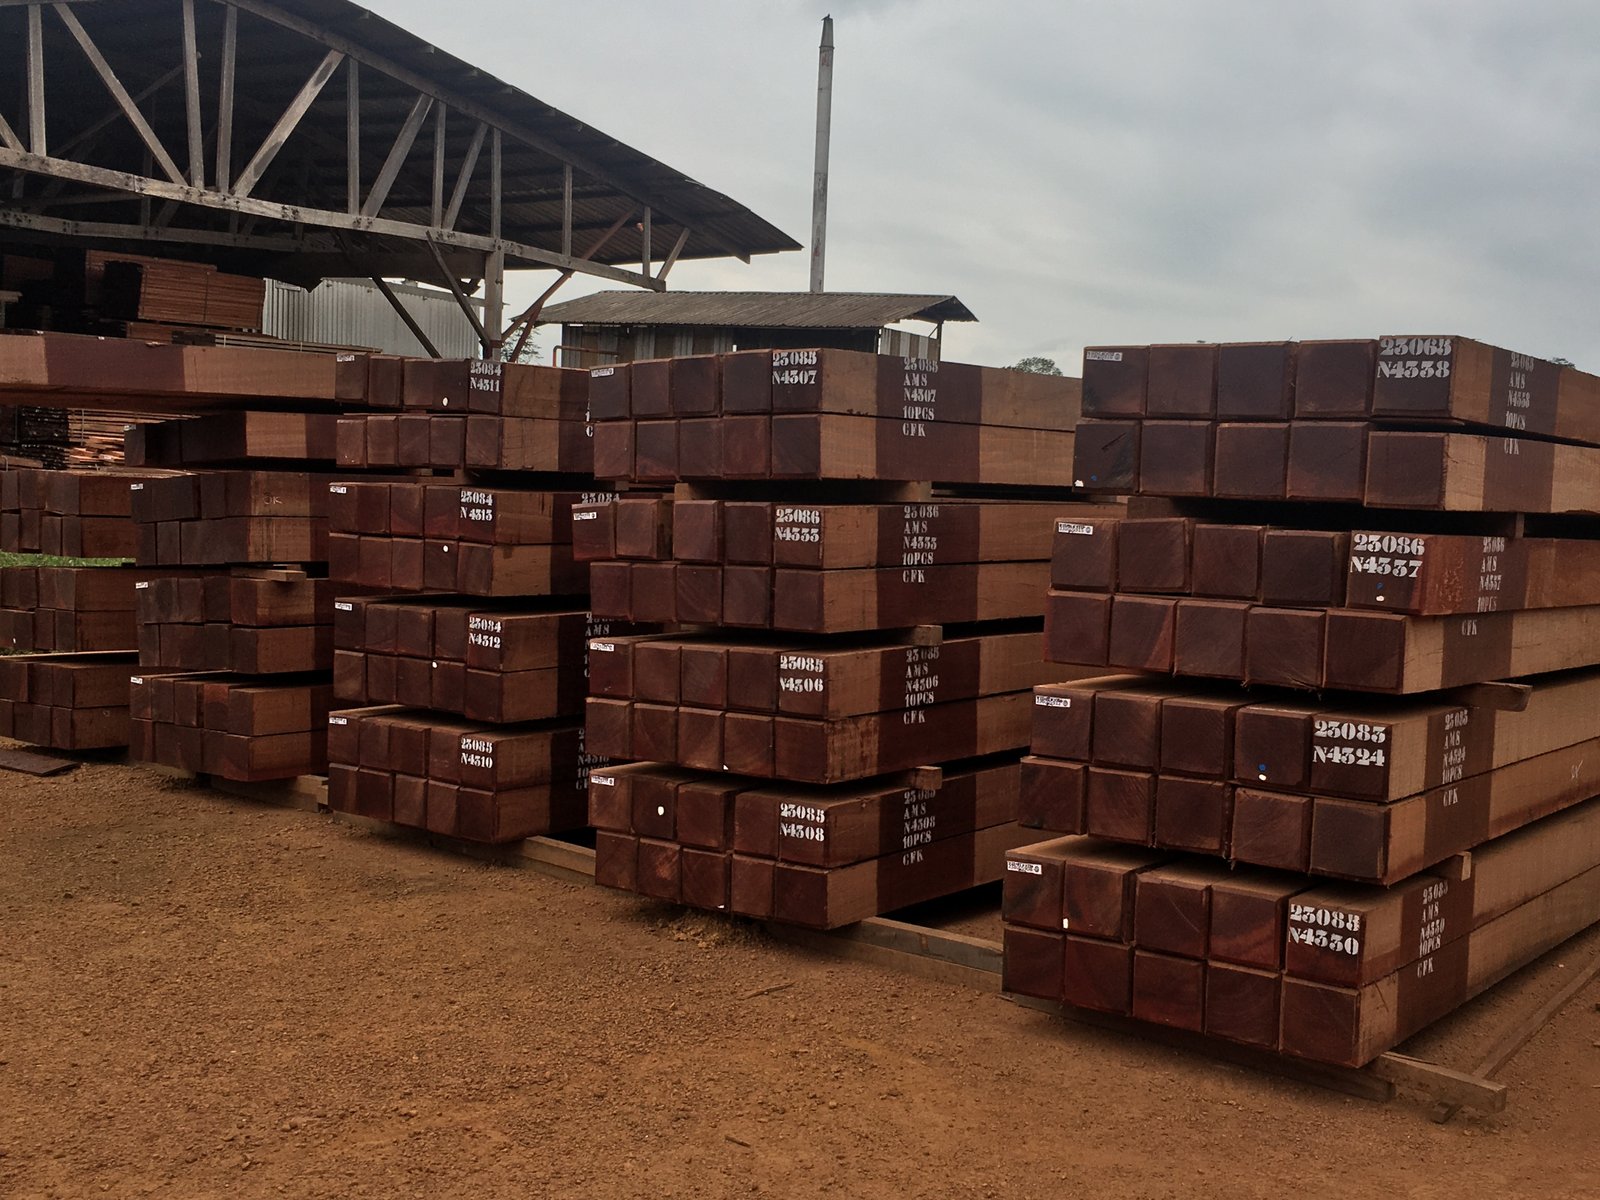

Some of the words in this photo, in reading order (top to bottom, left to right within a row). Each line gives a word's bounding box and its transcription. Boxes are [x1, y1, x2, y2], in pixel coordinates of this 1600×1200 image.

[470, 362, 502, 377] 23084
[772, 370, 817, 384] N4307
[1377, 361, 1450, 378] N4338
[470, 377, 500, 392] N4311
[903, 373, 928, 387] AMS
[1509, 371, 1526, 389] AMS
[903, 388, 936, 402] N4307
[902, 405, 935, 421] 10PCS
[1505, 411, 1526, 430] 10PCS
[902, 422, 926, 437] CFK
[460, 490, 493, 506] 23084
[775, 508, 820, 524] 23086
[903, 505, 939, 519] 23086
[775, 527, 820, 542] N4333
[903, 520, 928, 534] AMS
[903, 535, 937, 550] N4333
[1354, 533, 1425, 555] 23086
[902, 552, 934, 566] 10PCS
[1350, 556, 1423, 577] N4337
[1480, 555, 1498, 573] AMS
[902, 569, 925, 583] CFK
[1477, 596, 1497, 613] 10PCS
[469, 616, 502, 633] 23084
[585, 623, 610, 637] AMS
[468, 632, 501, 649] N4312
[780, 655, 824, 673] 23085
[905, 662, 929, 679] AMS
[779, 677, 824, 692] N4306
[905, 675, 939, 693] N4306
[905, 691, 935, 708] 10PCS
[903, 710, 926, 725] CFK
[1314, 720, 1386, 743] 23083
[1444, 730, 1460, 750] AMS
[461, 737, 493, 754] 23085
[460, 752, 493, 768] N4310
[1312, 745, 1385, 766] N4324
[1442, 764, 1463, 785] 10PCS
[780, 802, 826, 824] 23085
[903, 801, 927, 820] AMS
[779, 822, 825, 842] N4308
[903, 815, 936, 835] N4308
[902, 830, 932, 849] 10PCS
[902, 849, 924, 866] CFK
[1422, 901, 1439, 923] AMS
[1288, 927, 1359, 955] N4330
[1419, 934, 1441, 958] 10PCS
